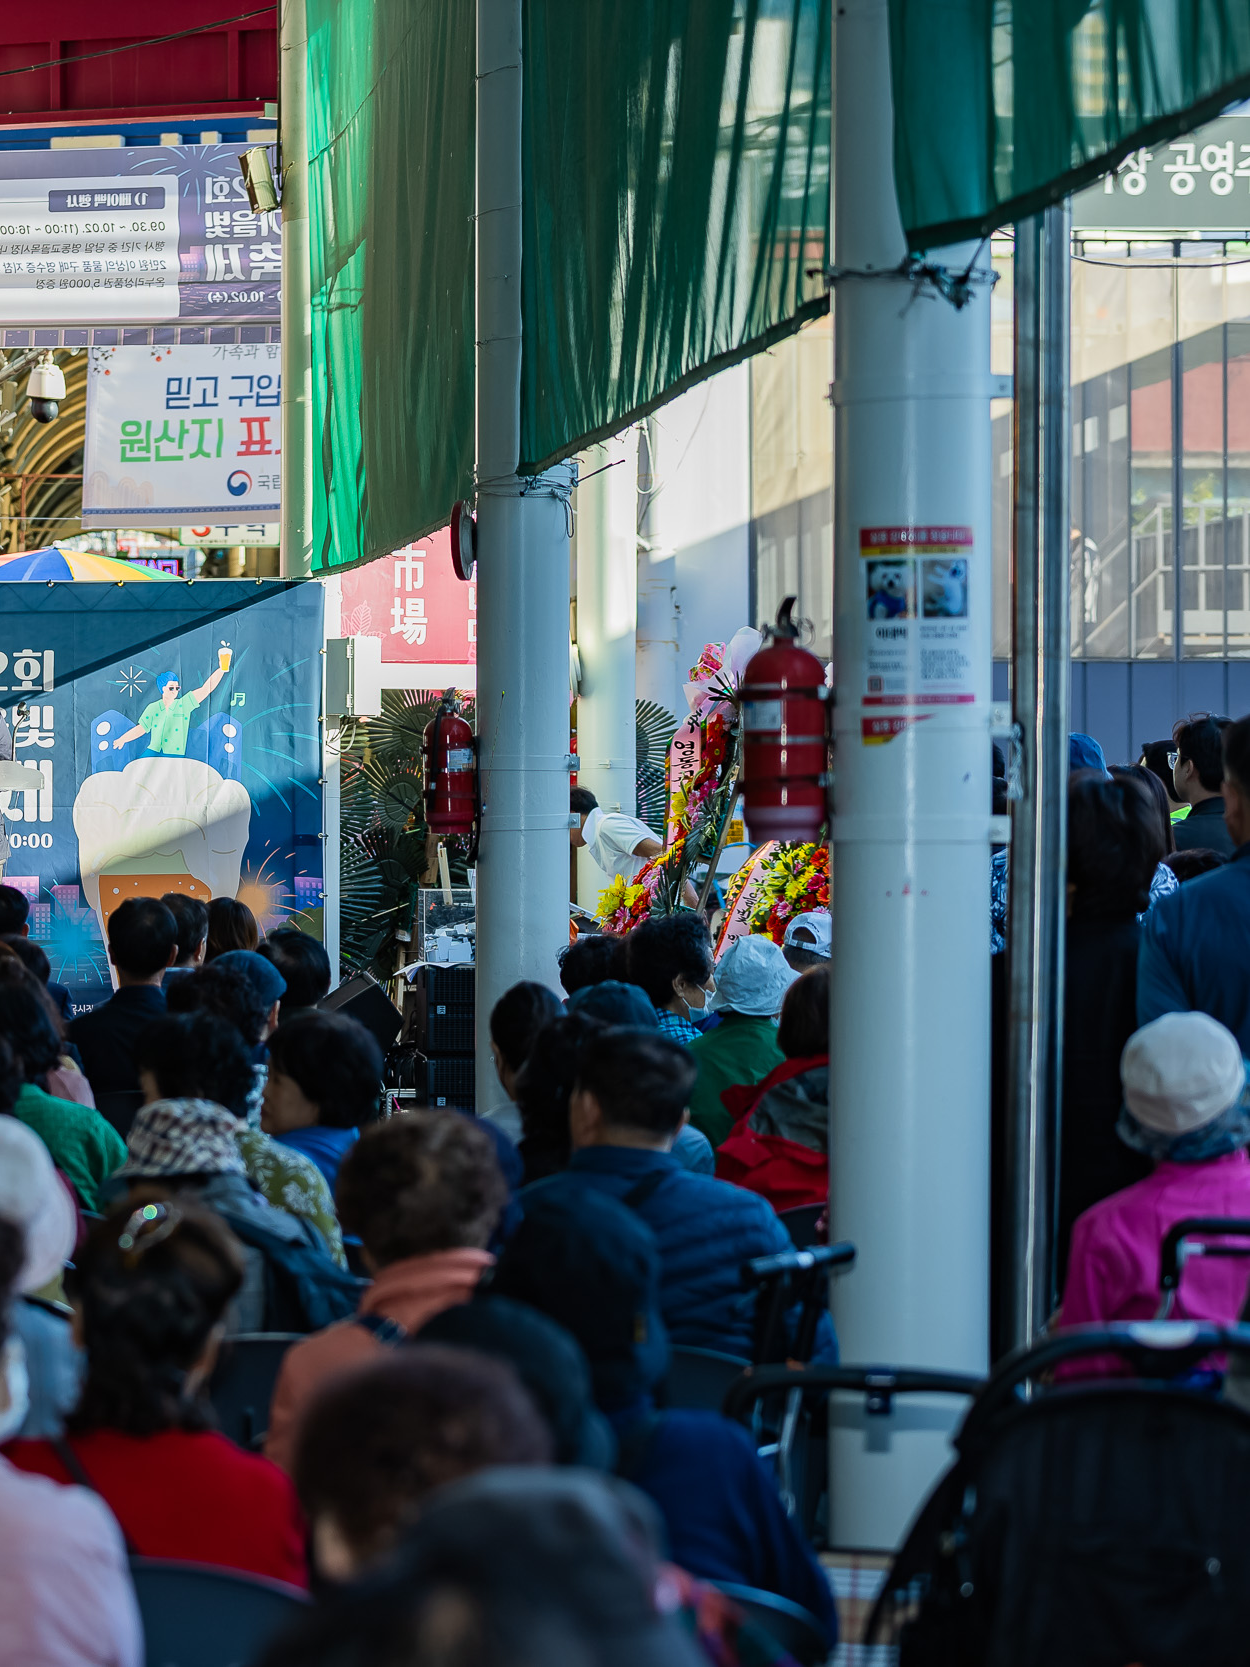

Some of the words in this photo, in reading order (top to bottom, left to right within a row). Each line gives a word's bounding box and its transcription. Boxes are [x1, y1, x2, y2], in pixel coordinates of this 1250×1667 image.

[165, 375, 219, 410] 믿고
[119, 417, 224, 463] 원산지
[236, 416, 281, 458] 표
